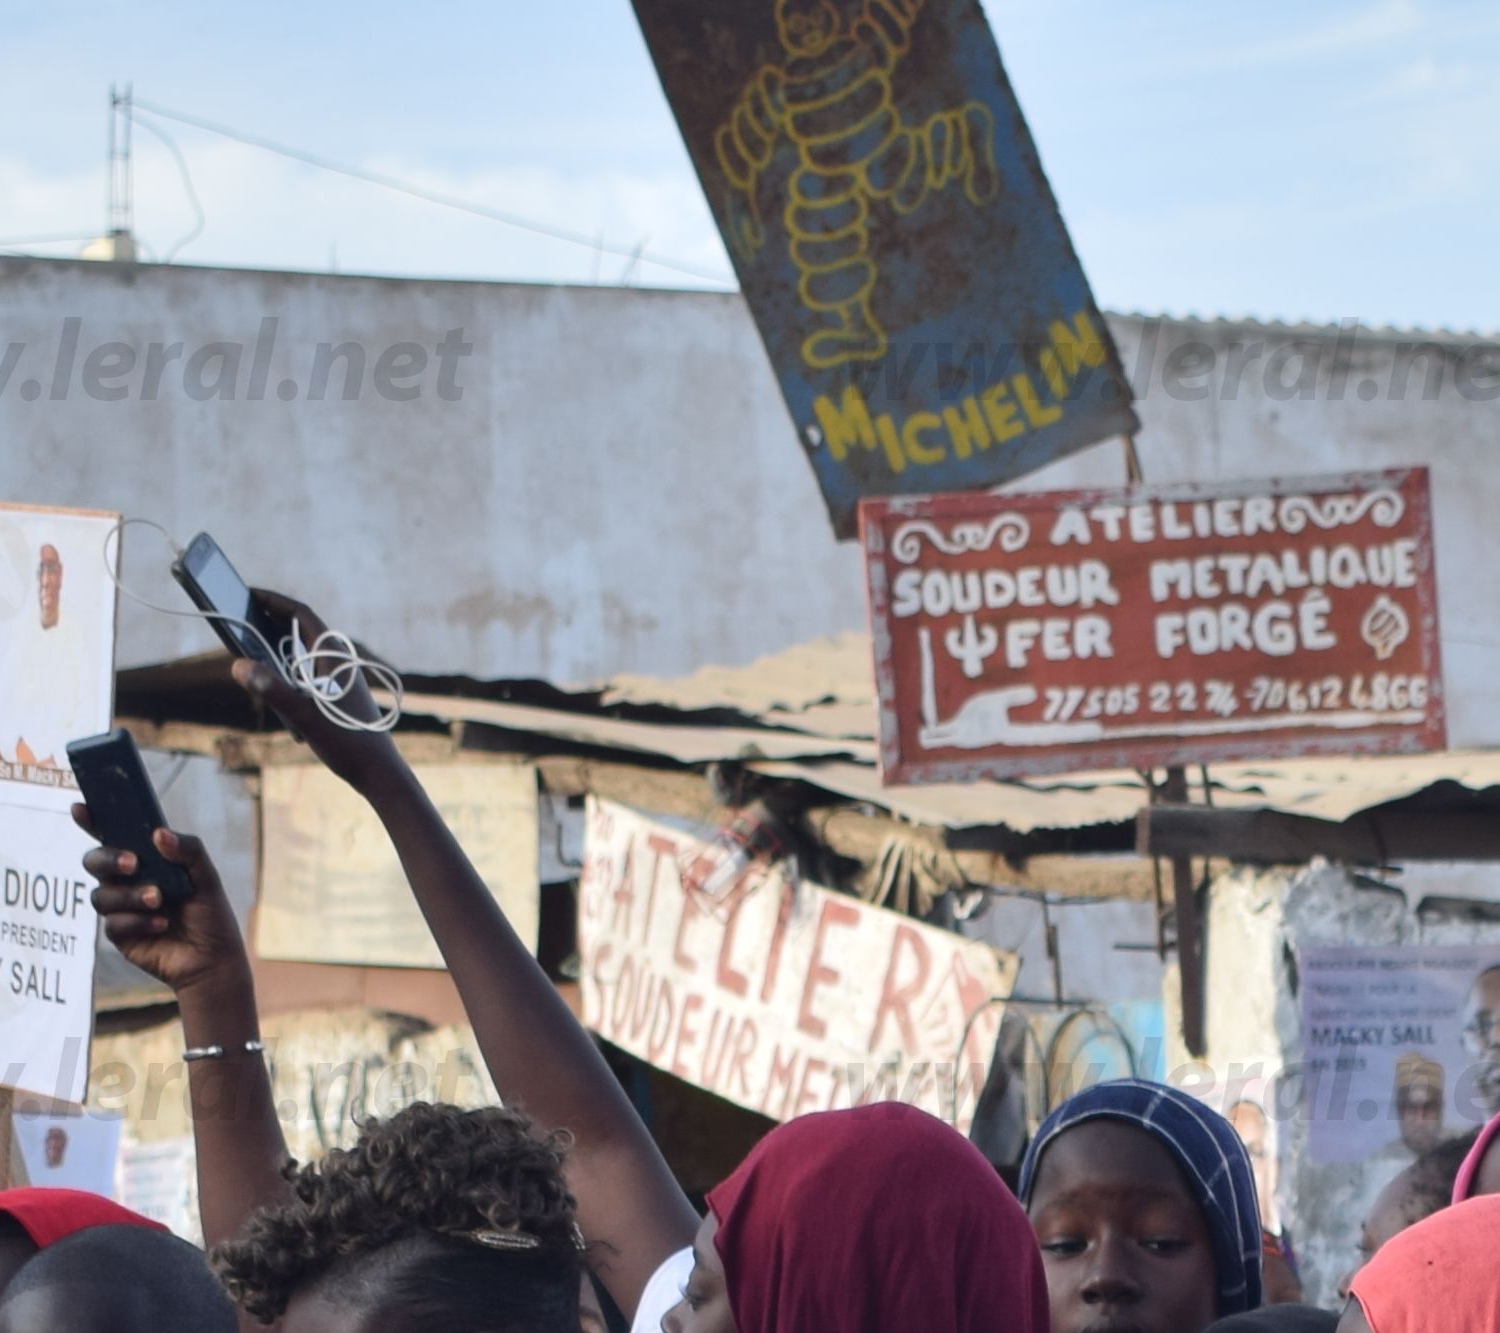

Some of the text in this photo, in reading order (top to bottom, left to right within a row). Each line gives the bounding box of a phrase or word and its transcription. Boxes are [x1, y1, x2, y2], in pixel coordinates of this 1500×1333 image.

[813, 311, 1106, 473] MICHELIN
[1050, 497, 1276, 545] ATELIER
[892, 540, 1418, 617] SOUDEUR METALIQUE
[1004, 615, 1114, 669] FER
[4, 867, 86, 921] DIOUF
[1, 921, 78, 957] PRESIDENT
[612, 832, 931, 1057] ATELIER
[10, 961, 67, 1005] SALL
[590, 944, 758, 1097] SOUDEUR
[1310, 1024, 1436, 1048] MACKY SALL
